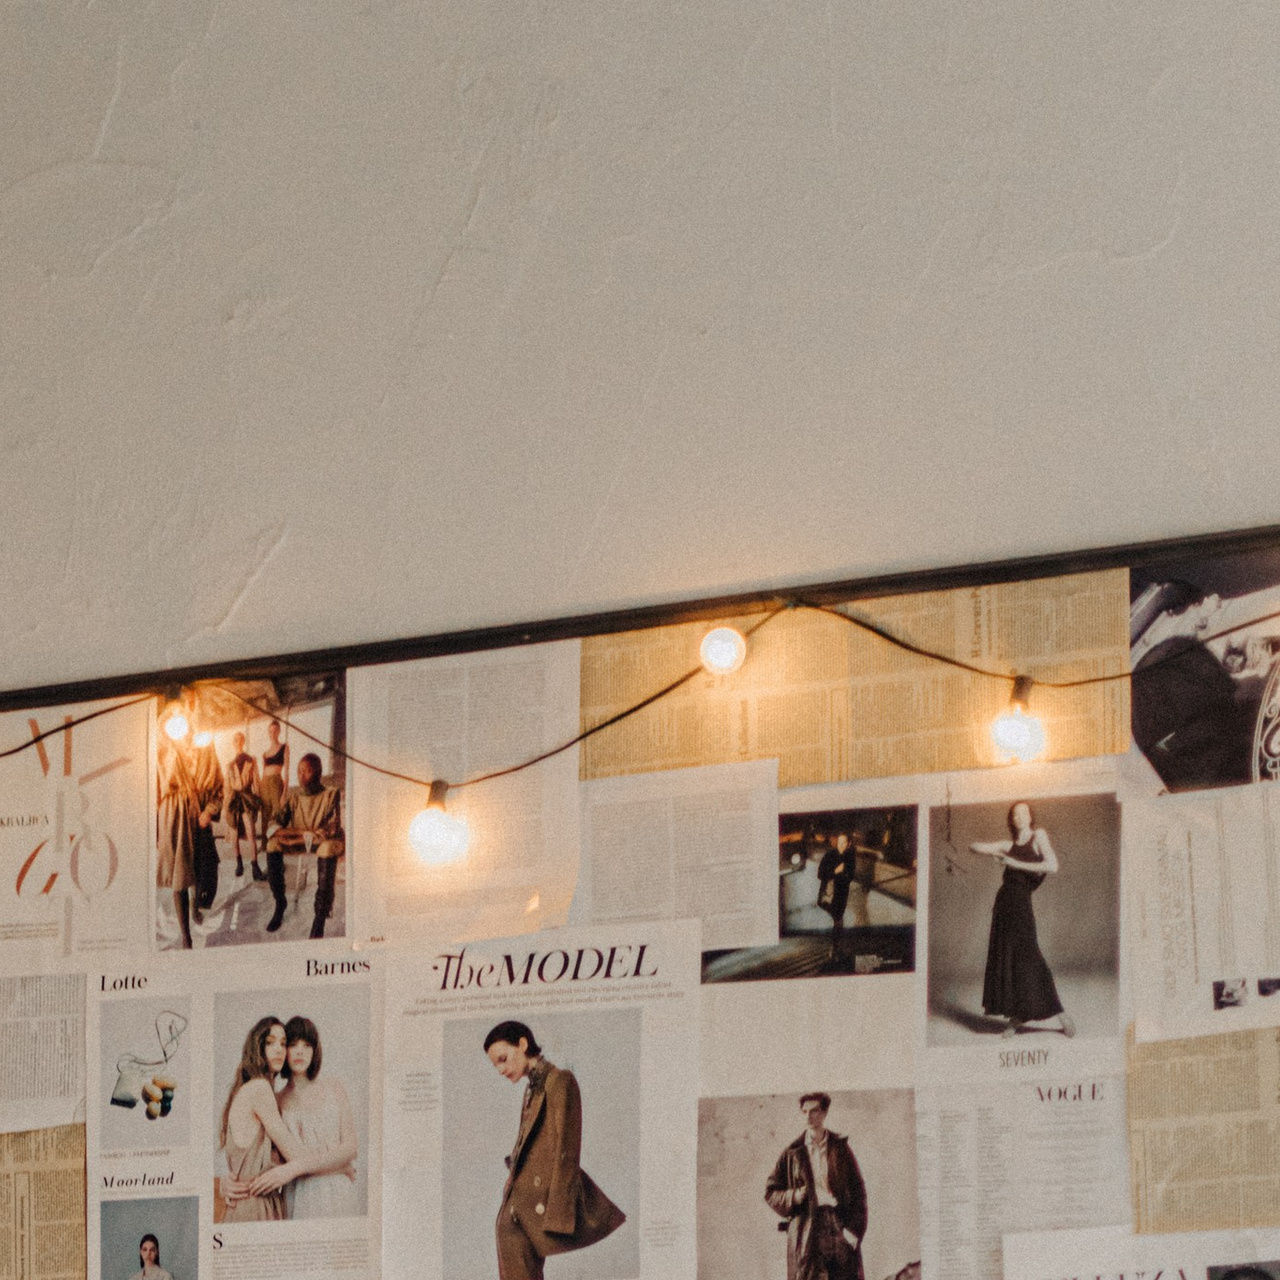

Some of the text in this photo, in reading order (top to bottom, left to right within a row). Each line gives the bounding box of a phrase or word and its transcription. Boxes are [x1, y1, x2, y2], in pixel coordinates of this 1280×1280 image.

[100, 958, 370, 992] Lotte Barnes
[496, 943, 659, 988] MODEL
[999, 1049, 1049, 1068] SEVENTY
[1036, 1082, 1104, 1102] VOGUE
[103, 1171, 175, 1188] Moorland
